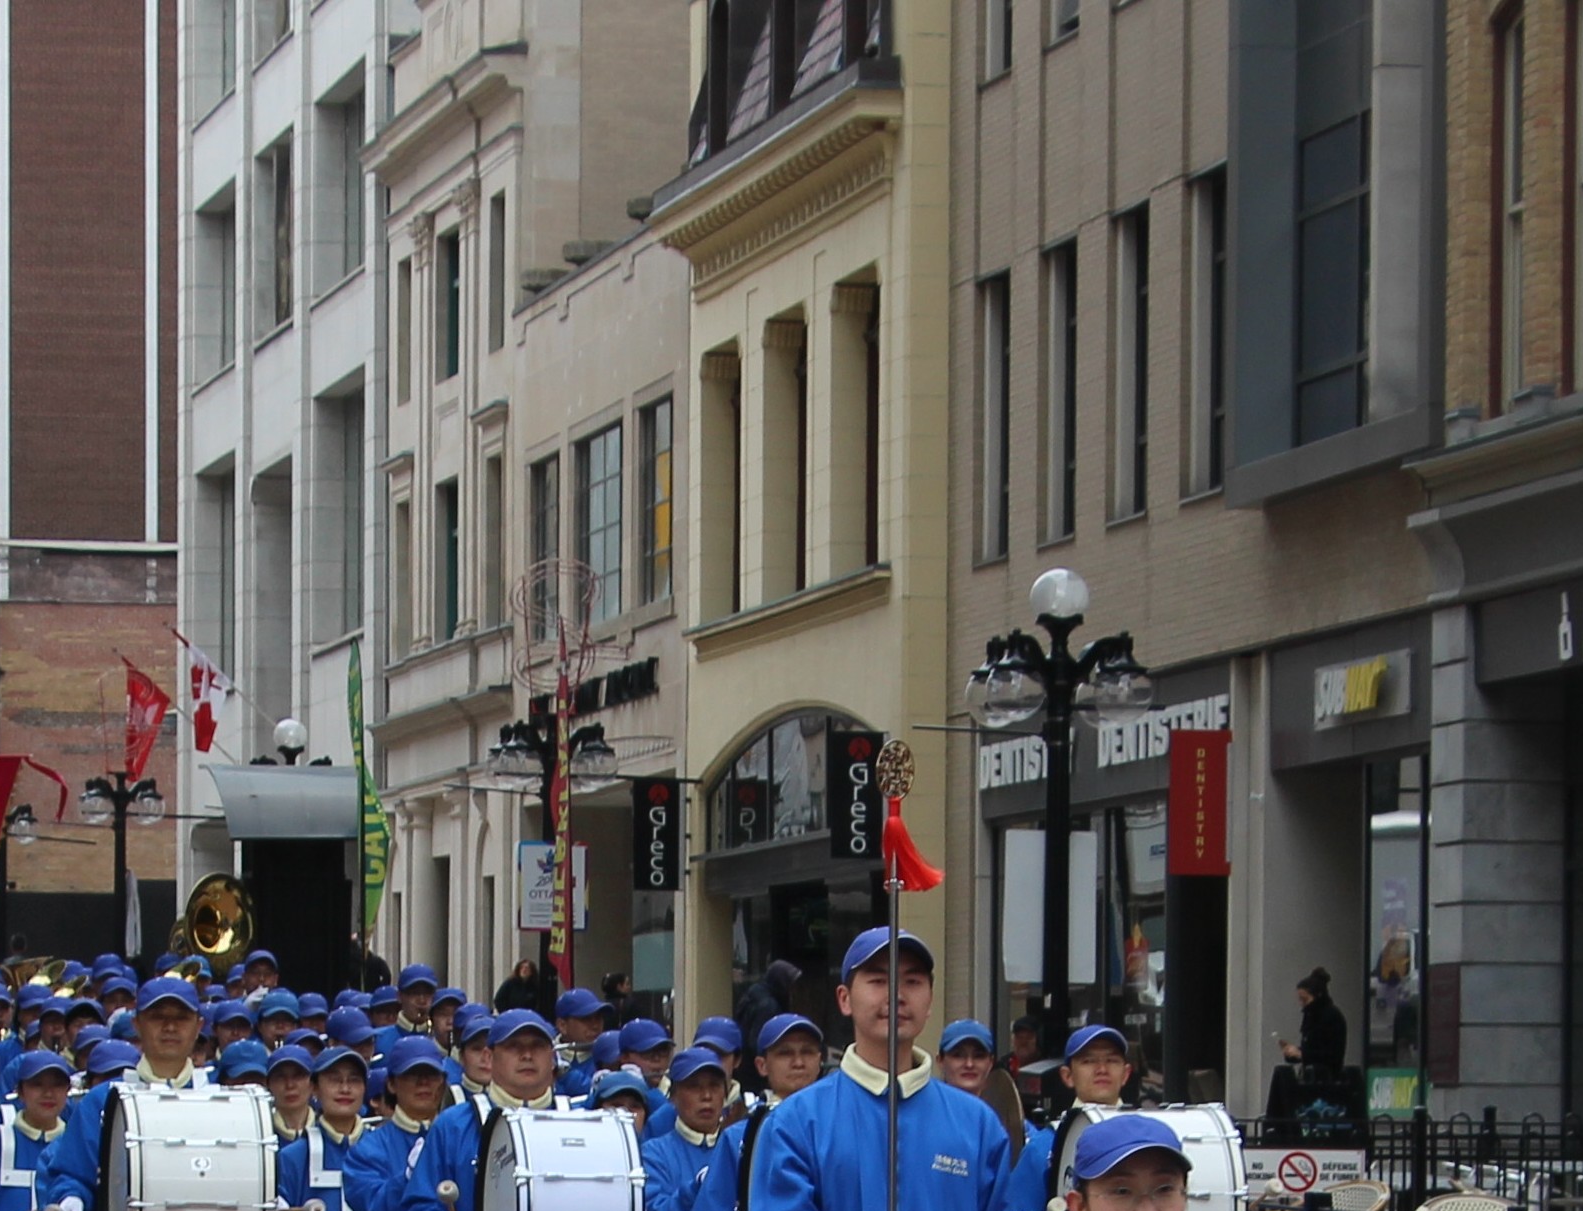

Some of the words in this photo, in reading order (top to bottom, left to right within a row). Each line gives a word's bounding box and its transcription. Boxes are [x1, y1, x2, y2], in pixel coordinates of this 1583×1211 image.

[1315, 654, 1388, 719] SUBWAY
[848, 762, 868, 854] Greco
[1195, 747, 1206, 859] DENTISTRY
[648, 806, 667, 886] Greco
[1369, 1074, 1418, 1111] SUBWAY
